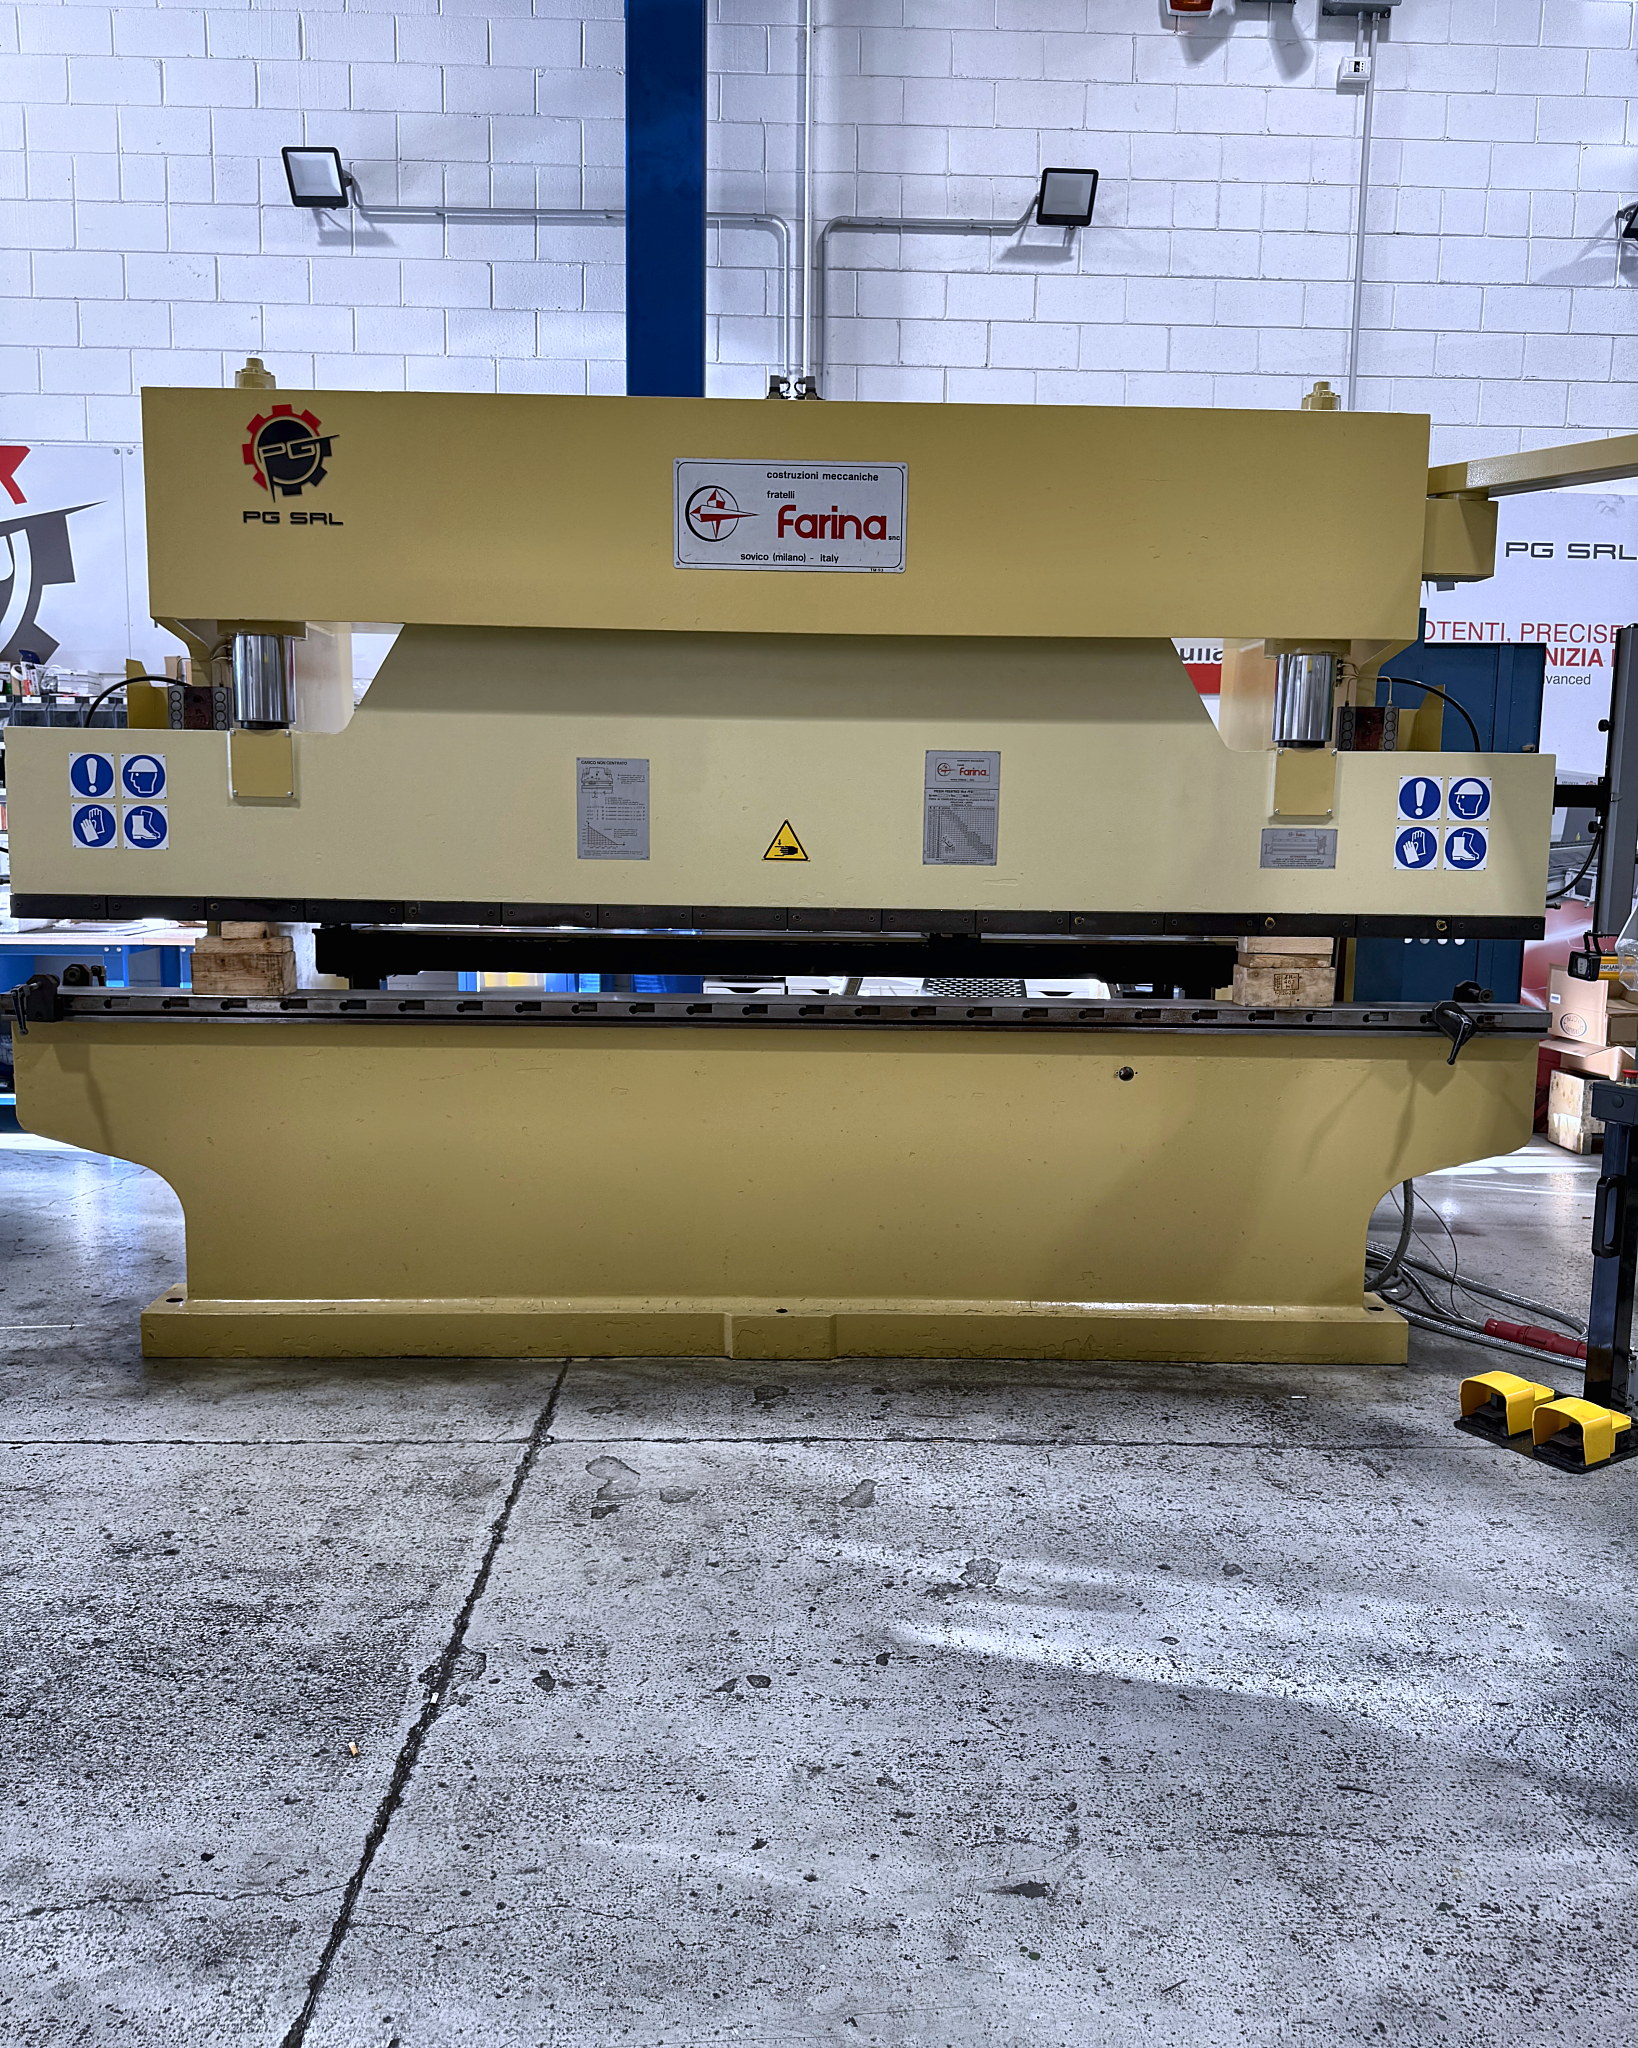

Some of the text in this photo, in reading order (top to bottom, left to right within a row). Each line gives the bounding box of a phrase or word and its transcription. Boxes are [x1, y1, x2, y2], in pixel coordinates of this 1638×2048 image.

[766, 471, 879, 482] costruzioni meccaniche
[766, 490, 795, 499] fratelli
[243, 511, 344, 526] PG SRL
[1505, 541, 1638, 561] PG SRL
[740, 553, 769, 562] sovico
[772, 553, 806, 563] (milano)
[820, 553, 839, 564] italy
